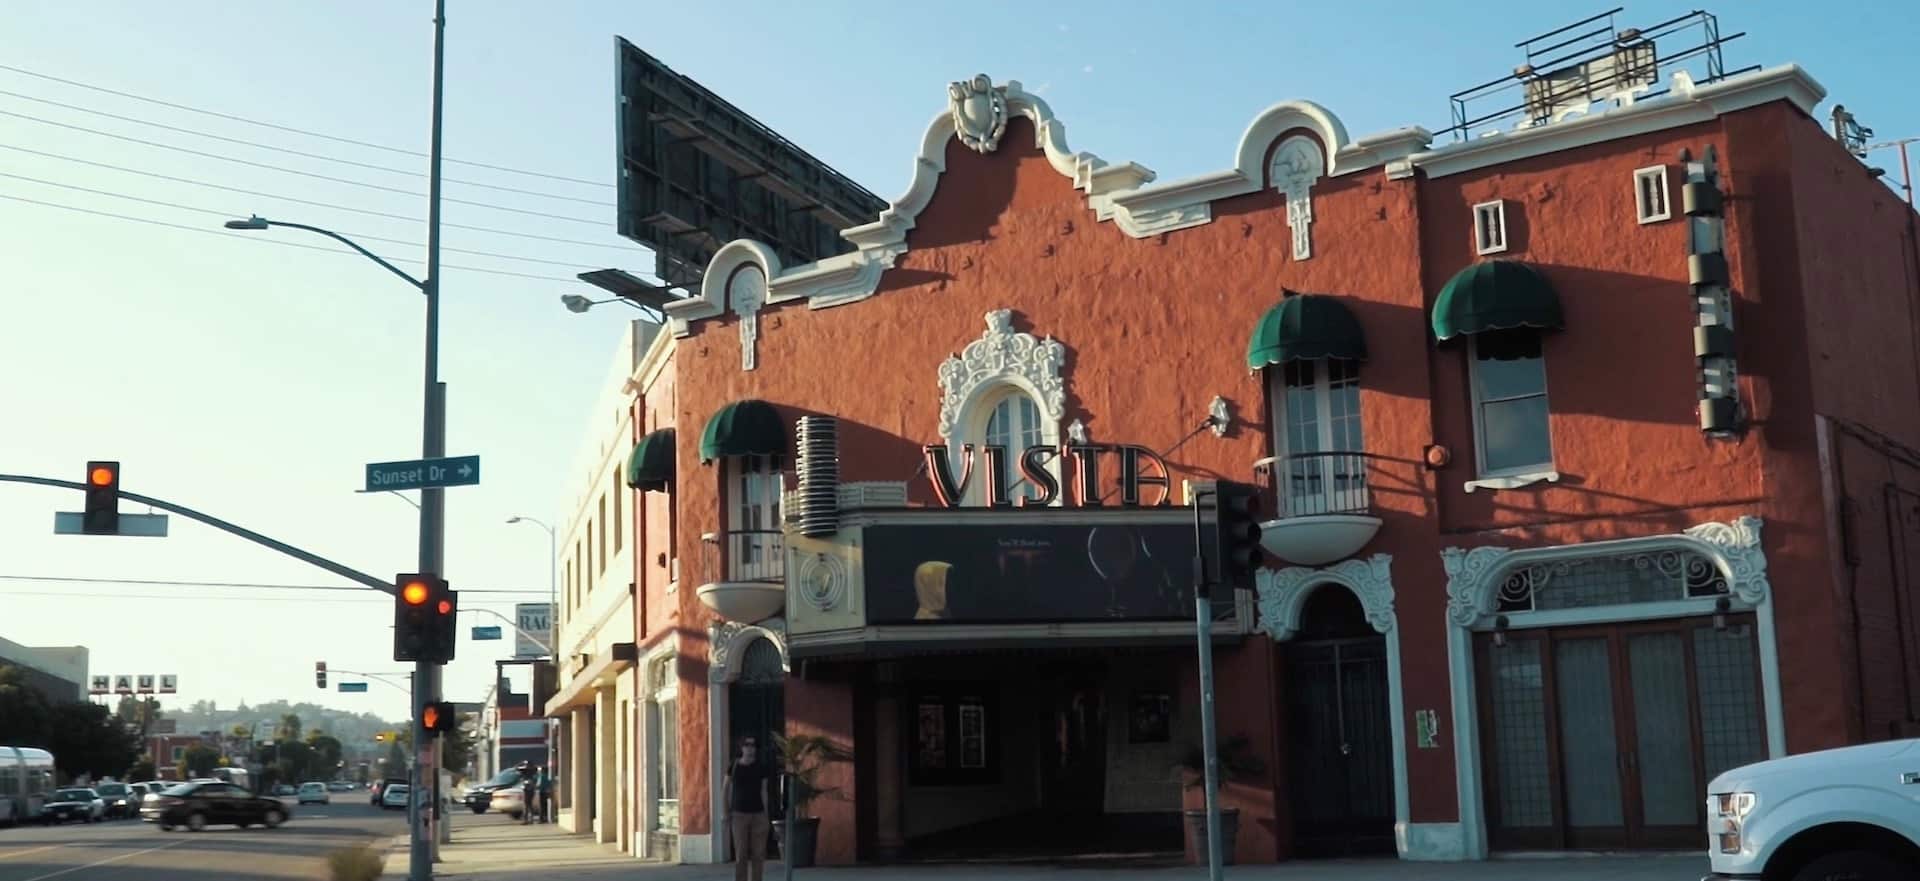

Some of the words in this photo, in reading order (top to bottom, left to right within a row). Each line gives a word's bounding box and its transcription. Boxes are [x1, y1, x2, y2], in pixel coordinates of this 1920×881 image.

[372, 467, 423, 485] Sunset
[429, 466, 446, 481] Dr
[923, 443, 1171, 507] VISTA
